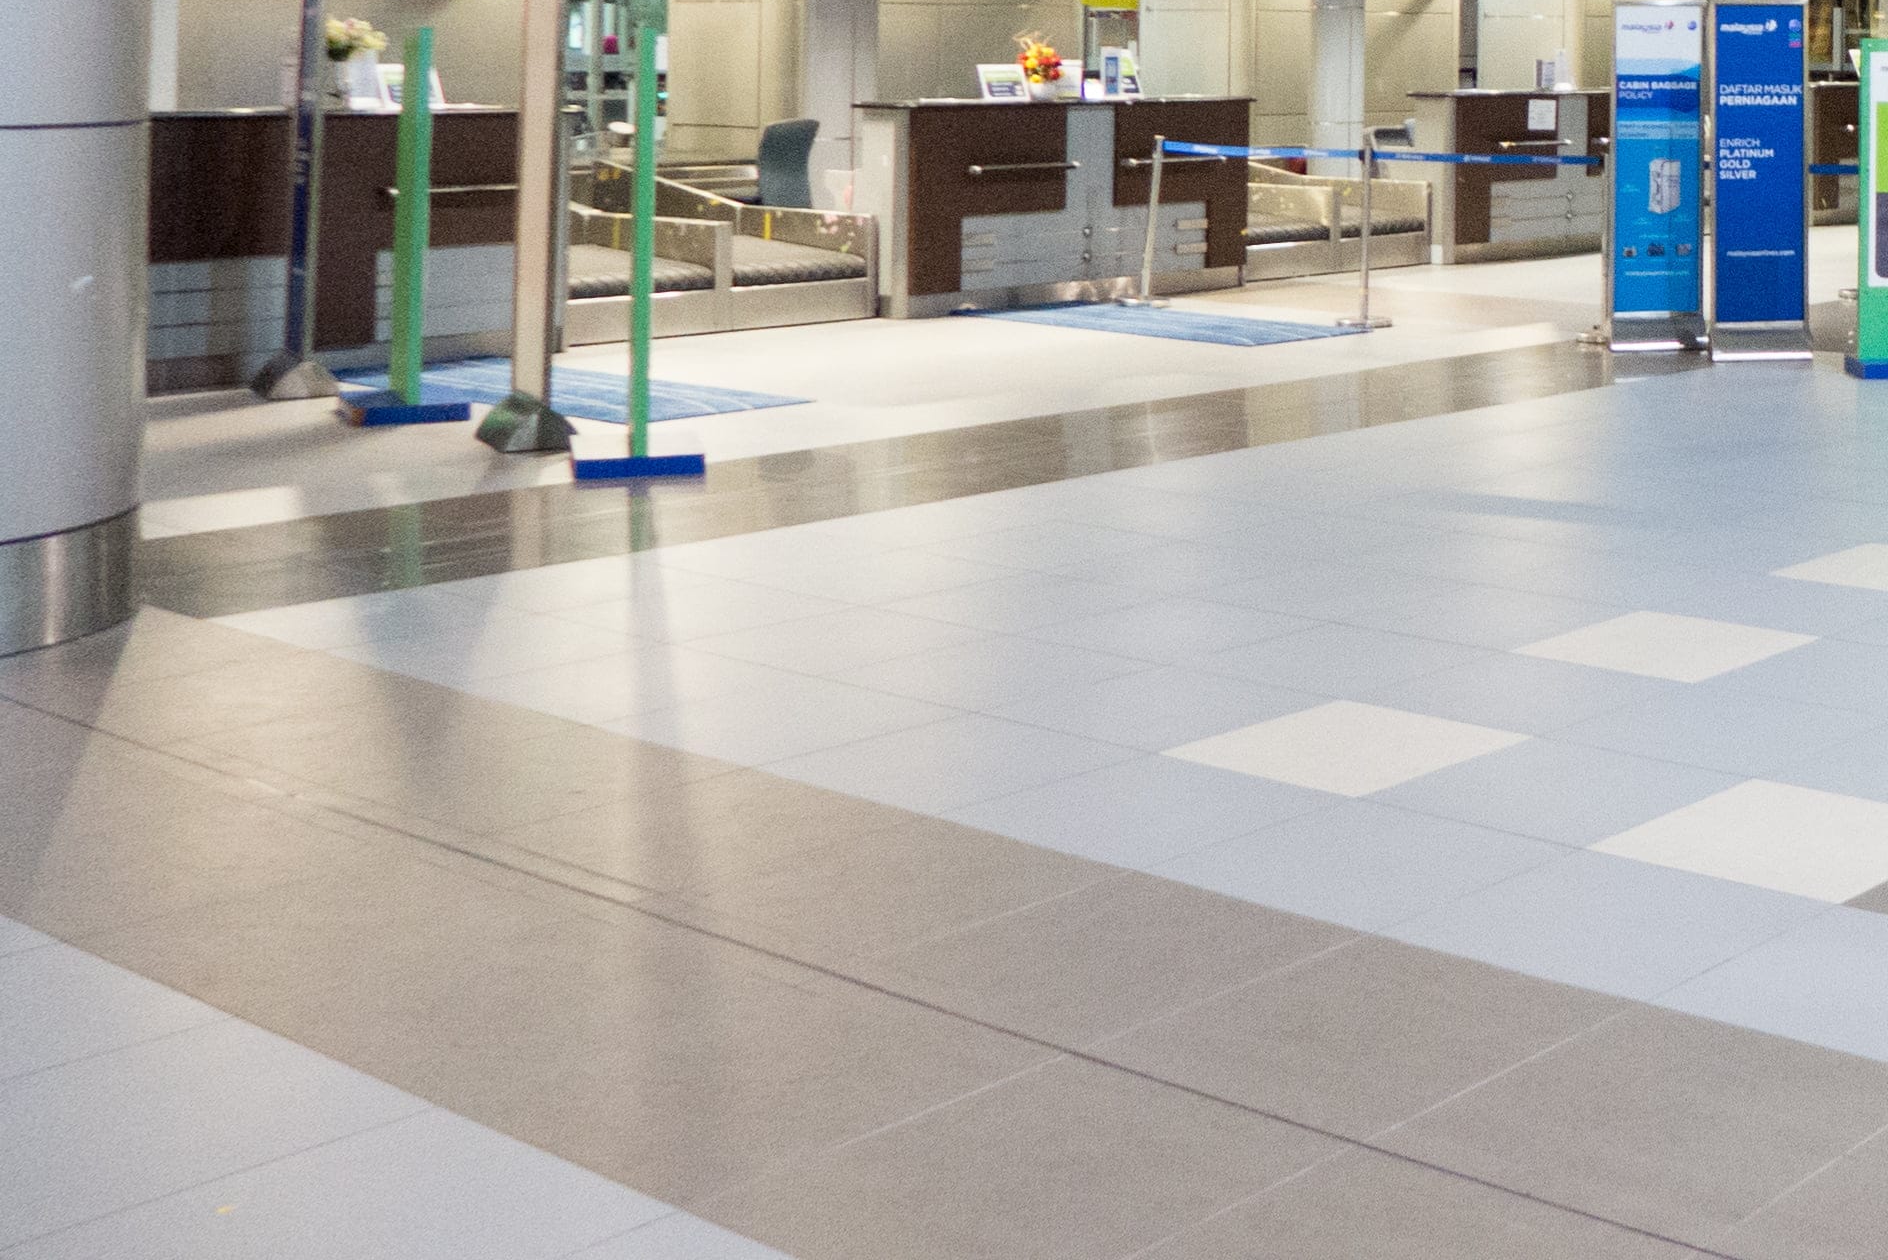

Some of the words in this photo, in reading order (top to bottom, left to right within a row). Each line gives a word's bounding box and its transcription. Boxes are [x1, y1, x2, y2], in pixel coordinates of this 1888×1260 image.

[1619, 81, 1650, 90] CABIN
[1651, 81, 1698, 90] BAGGAGE
[1719, 84, 1763, 95] DAFTAR
[1764, 84, 1804, 95] MASUK
[1619, 91, 1654, 100] POLICY
[1719, 95, 1798, 106] PERNIAGAAN
[1719, 138, 1760, 148] ENRICH
[1719, 148, 1775, 158] PLATINUM
[1719, 159, 1751, 169] GOLD
[1719, 170, 1757, 180] SILVER
